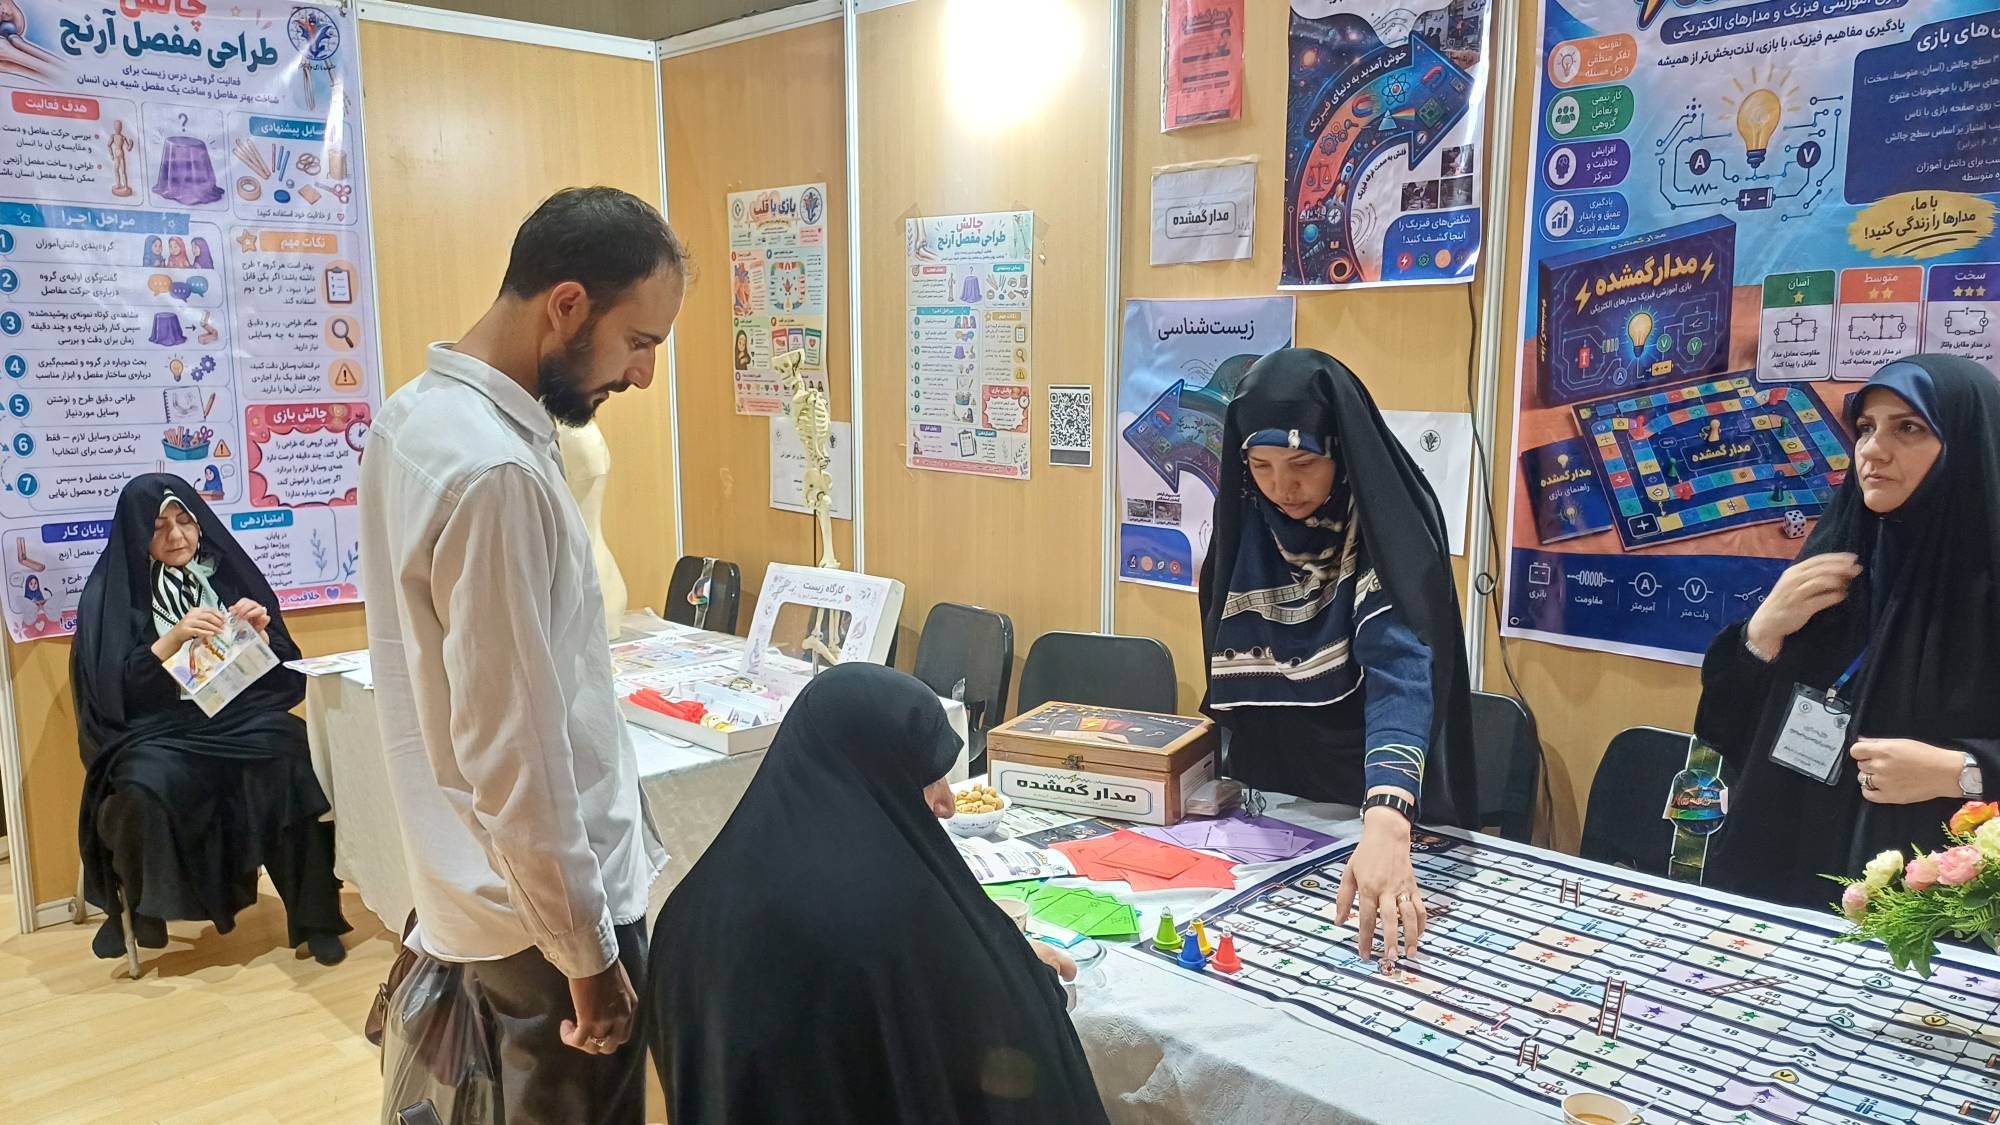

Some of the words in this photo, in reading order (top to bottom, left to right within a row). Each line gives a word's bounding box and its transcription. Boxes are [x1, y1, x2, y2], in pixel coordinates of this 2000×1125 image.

[1783, 1, 1819, 21] فیزیک
[1725, 11, 1770, 31] مدارهای
[59, 8, 116, 55] آرنج
[1672, 18, 1722, 40] الکتریکی
[1865, 18, 1906, 38] یادگیری
[123, 21, 201, 57] مفصل
[1781, 37, 1788, 50] با
[1789, 34, 1822, 50] فیزیک،
[1824, 28, 1863, 46] مفاهیم
[1917, 28, 1950, 52] بازی
[208, 32, 278, 72] طراحی
[1755, 39, 1778, 56] بازی،
[1384, 50, 1407, 69] خوش
[1657, 56, 1689, 68] همیشه
[1691, 52, 1698, 65] از
[122, 65, 140, 75] برای
[141, 69, 165, 79] زیست
[1360, 56, 1383, 79] آمدید
[1611, 64, 1623, 76] حل
[1624, 66, 1629, 74] و
[77, 74, 100, 84] انسان
[102, 77, 118, 88] بدن
[167, 73, 187, 81] درس
[189, 74, 215, 84] گروهی
[216, 75, 241, 85] فعالیت
[1351, 75, 1360, 84] به
[120, 80, 139, 88] شبیه
[141, 82, 164, 92] مفصل
[167, 85, 180, 95] یک
[182, 87, 205, 96] ساخت
[214, 90, 238, 100] مفاصل
[240, 94, 253, 102] بهتر
[1331, 79, 1351, 106] دنیای
[1611, 90, 1622, 101] کار
[25, 98, 59, 111] فعالیت
[254, 94, 279, 103] شناخت
[1591, 92, 1609, 105] تیمی
[62, 99, 87, 112] هدف
[1613, 106, 1619, 115] و
[1309, 101, 1331, 134] فیزیک
[1591, 108, 1612, 118] تعامل
[261, 121, 300, 136] پیشنهادی
[1592, 118, 1617, 131] گروهی
[1591, 144, 1617, 158] افزایش
[1803, 148, 1815, 162] V
[1592, 158, 1619, 170] خلاقیت
[1694, 155, 1706, 169] A
[1592, 172, 1612, 184] تمرکز
[771, 199, 776, 216] با
[778, 197, 796, 216] بازی
[1589, 199, 1614, 210] یادگیری
[1911, 195, 1927, 212] ما،
[1929, 195, 1938, 209] با
[753, 200, 769, 219] قلب
[1603, 210, 1621, 220] عمیق
[61, 210, 91, 226] اجرا
[96, 212, 135, 227] مراحل
[1172, 208, 1207, 226] گمشده
[1207, 209, 1229, 224] مدار
[1578, 212, 1596, 224] پایدار
[1932, 215, 1940, 230] را
[1942, 210, 1976, 225] مدارها
[956, 216, 983, 233] چالش
[1399, 221, 1405, 231] را
[1405, 220, 1430, 229] فیزیک
[1575, 224, 1595, 234] فیزیک
[1596, 224, 1621, 233] مفاهیم
[1864, 220, 1895, 241] کنید!
[1896, 218, 1930, 238] زندگی
[938, 231, 955, 250] آرنج
[956, 232, 981, 247] مفصل
[981, 230, 1006, 247] طراحی
[1402, 235, 1421, 244] کنید!
[1422, 233, 1448, 244] کشف
[1450, 232, 1466, 241] اینجا
[1595, 256, 1655, 296] گمشده
[1653, 253, 1698, 287] مدار
[1954, 271, 1986, 281] سخت
[2, 274, 12, 288] 2
[1788, 276, 1810, 290] آسان
[1864, 272, 1898, 284] متوسط
[6, 316, 16, 330] 3
[1158, 317, 1255, 341] زیست‌شناسی
[9, 360, 21, 373] 4
[86, 358, 101, 367] گروه
[112, 358, 130, 366] دوباره
[133, 358, 146, 366] بحث
[15, 399, 24, 413] 5
[273, 408, 296, 424] بازی
[298, 407, 327, 424] چالش
[18, 438, 28, 451] 6
[1727, 443, 1751, 458] مدار
[1692, 445, 1726, 463] گمشده
[1540, 472, 1570, 488] گمشده
[1570, 468, 1592, 482] مدار
[22, 478, 31, 491] 7
[1564, 483, 1590, 499] راهنمای
[1548, 489, 1562, 501] بازی
[240, 512, 285, 528] امتیازدهی
[62, 525, 78, 540] کار
[82, 524, 104, 537] پایان
[803, 582, 824, 593] زیست
[825, 584, 845, 595] کارگاه
[1641, 579, 1650, 590] A
[1691, 584, 1700, 596] V
[1529, 589, 1547, 599] باتری
[1575, 594, 1603, 605] مقاومت
[1630, 601, 1656, 612] آمپرمتر
[1680, 609, 1692, 619] متر
[1693, 610, 1710, 621] ولت
[1016, 779, 1089, 796] گمشده
[1093, 788, 1137, 803] مدار
[1430, 959, 1446, 967] 37
[1784, 972, 1799, 980] 73
[1493, 980, 1509, 988] 36
[1671, 988, 1687, 996] 54
[1948, 994, 1967, 1002] 89
[1838, 1008, 1855, 1018] 69
[1625, 1023, 1643, 1032] 34
[1722, 1027, 1740, 1036] 48
[1916, 1033, 1933, 1041] 70
[1678, 1064, 1697, 1074] 28
[1656, 1086, 1672, 1096] 13
